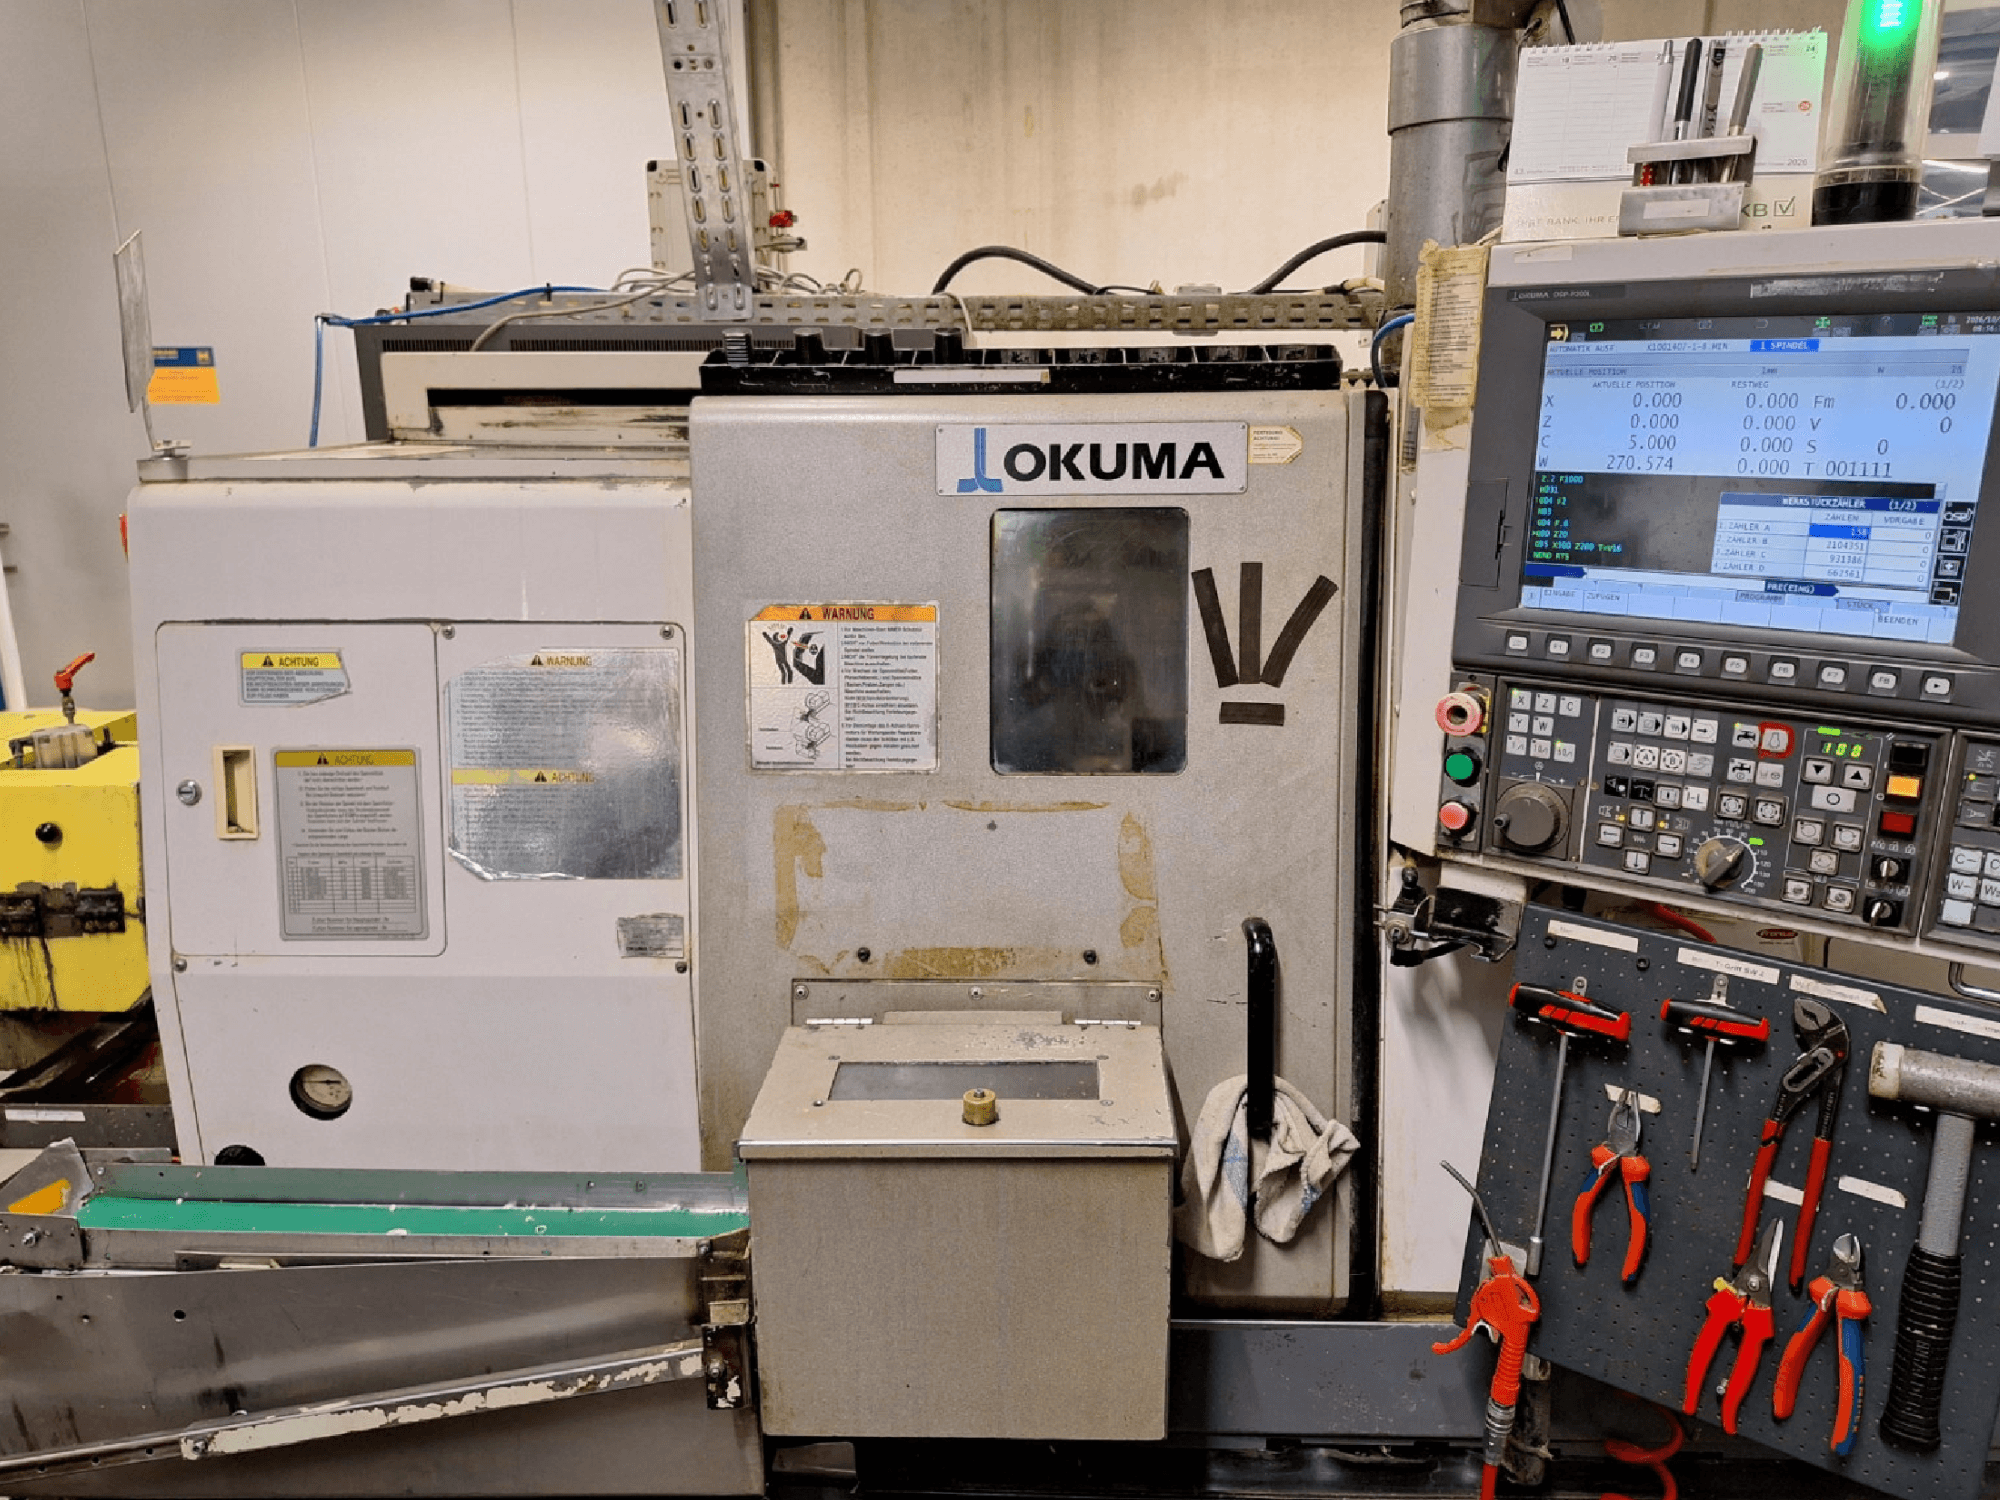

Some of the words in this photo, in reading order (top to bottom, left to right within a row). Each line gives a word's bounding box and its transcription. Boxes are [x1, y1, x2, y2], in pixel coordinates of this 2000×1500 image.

[1592, 381, 1632, 389] AKTUELLE
[1635, 381, 1676, 389] POSITION
[1731, 381, 1769, 389] RESTWEG
[1544, 395, 1554, 407] X
[1632, 393, 1682, 408] 0.000
[1745, 393, 1799, 409] 0.000
[1813, 395, 1835, 409] Fm
[1895, 393, 1956, 410] 0.000
[1542, 416, 1552, 428] Z
[1630, 414, 1679, 430] 0.000
[1742, 415, 1796, 431] 0.000
[1809, 418, 1822, 430] V
[1939, 416, 1953, 434] 0
[1541, 436, 1550, 448] C
[1627, 435, 1677, 451] 5.000
[1739, 437, 1793, 453] 0.000
[1806, 440, 1817, 453] S
[1877, 439, 1889, 456] 0
[1003, 442, 1225, 482] OKUMA
[1538, 457, 1548, 468] W
[1606, 455, 1673, 471] 270.574
[1737, 457, 1790, 475] 0.000
[1803, 462, 1815, 477] T
[1825, 461, 1893, 478] 001111
[1888, 500, 1917, 512] (1/2)
[1883, 516, 1925, 526] VORGABE
[822, 607, 875, 621] WARNUNG
[1877, 615, 1918, 626] BEENDEN
[278, 656, 319, 667] ACHTUNG
[546, 656, 593, 667] WARNUNG
[334, 754, 374, 766] ACHTUNG
